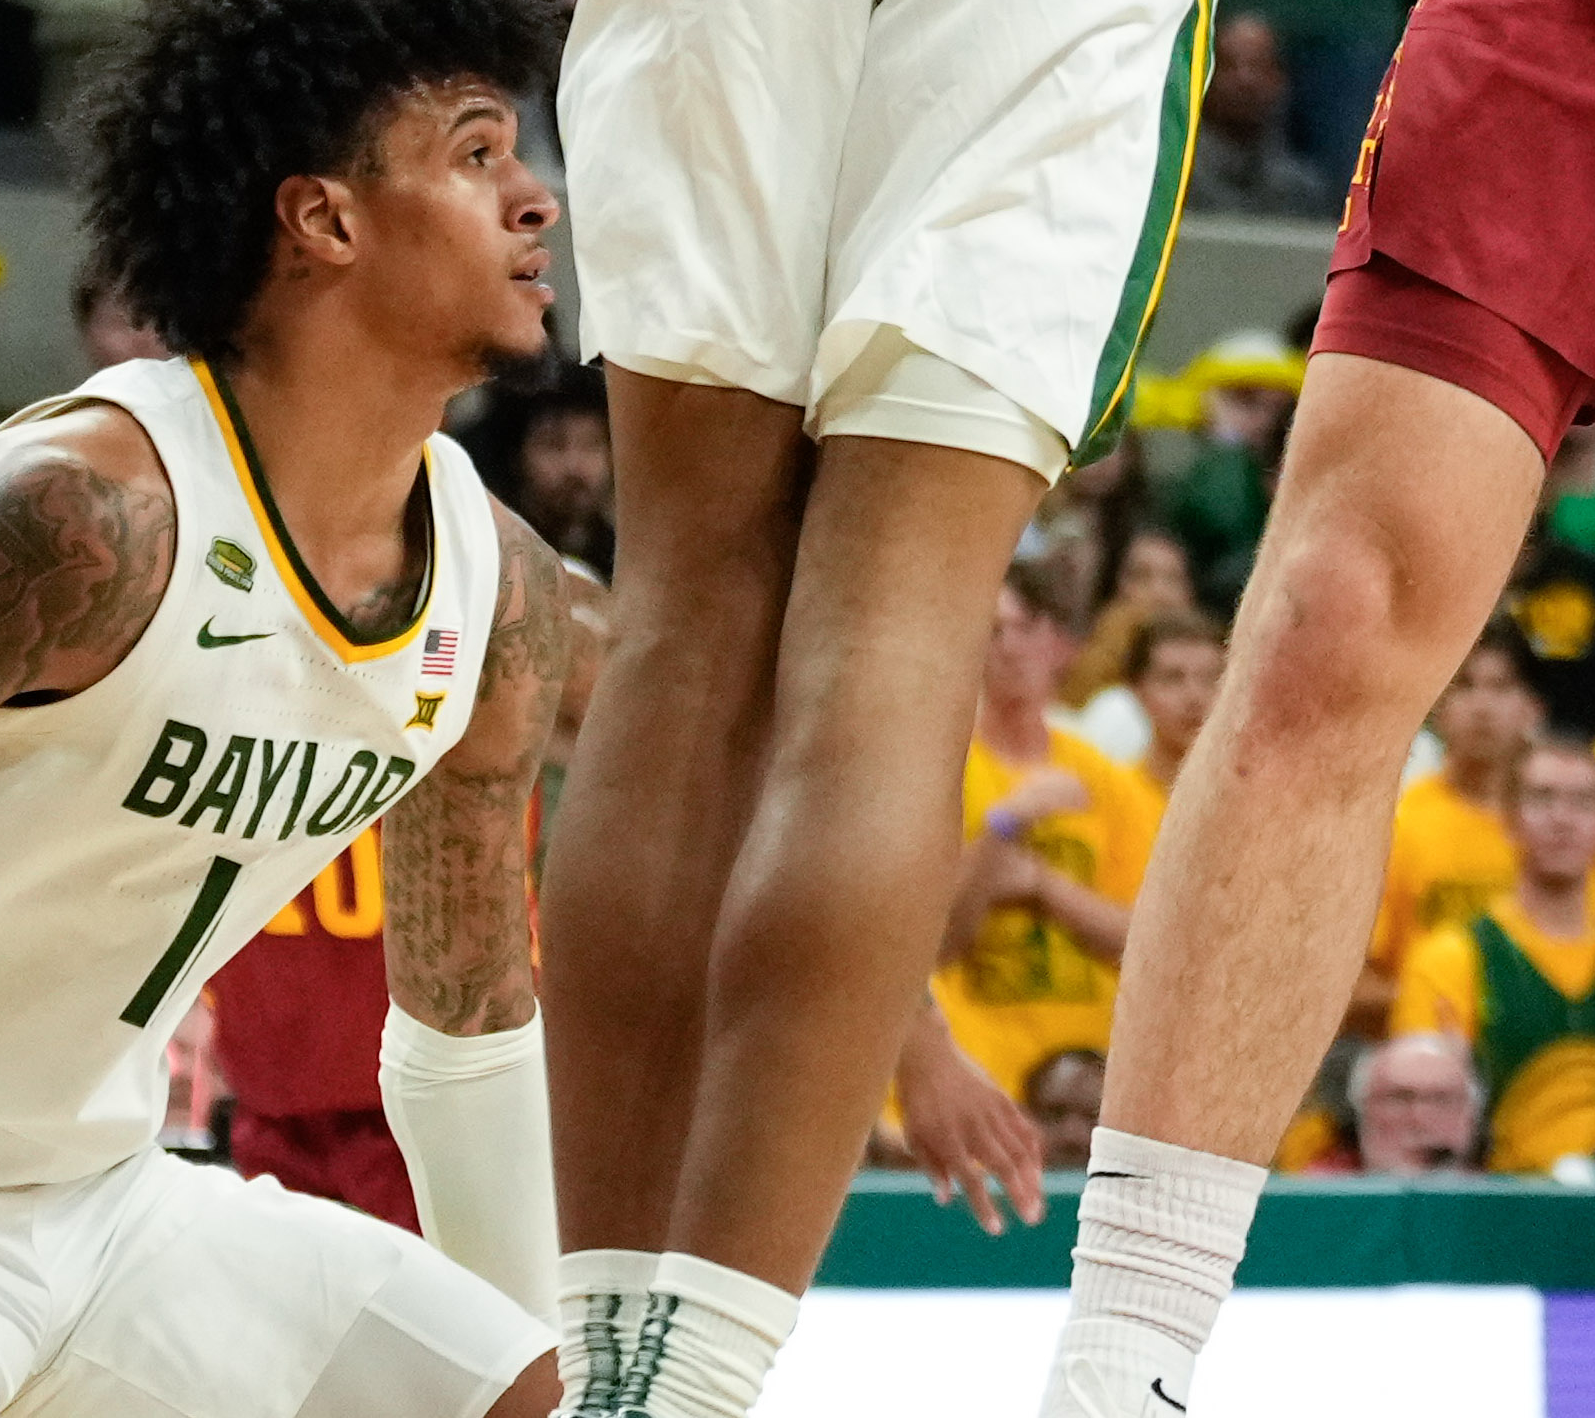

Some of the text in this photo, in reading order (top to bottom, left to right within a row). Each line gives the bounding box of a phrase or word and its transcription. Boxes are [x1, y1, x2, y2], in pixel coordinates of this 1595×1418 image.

[120, 718, 416, 842] BAYLOR
[118, 854, 243, 1028] 1
[263, 824, 383, 940] 0
